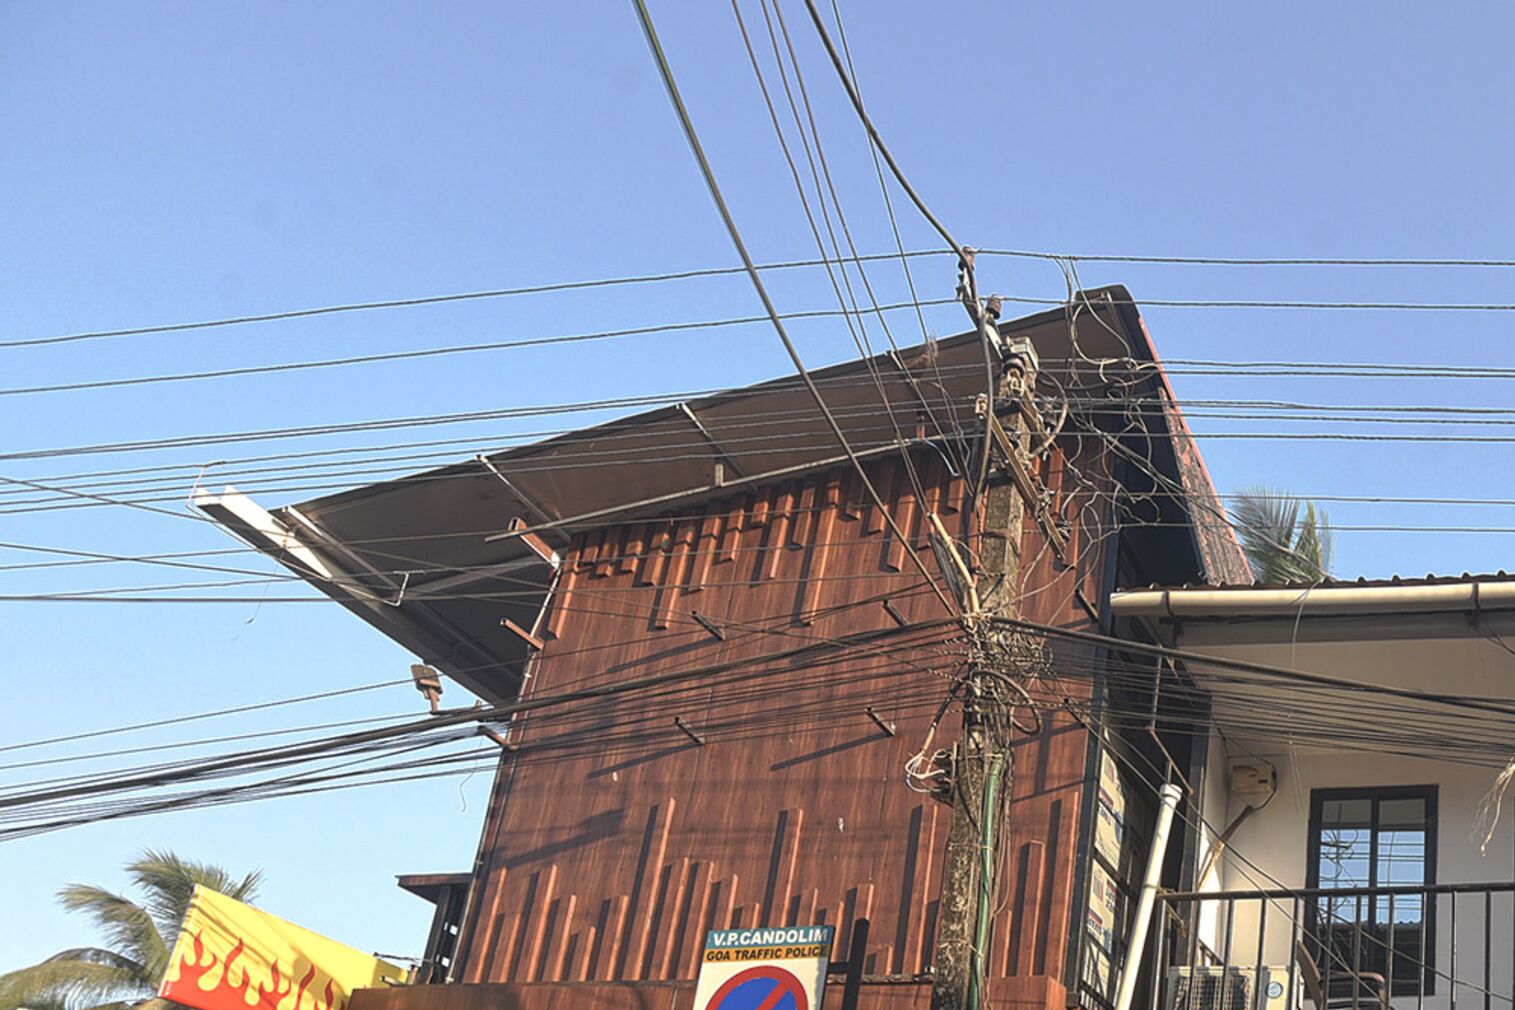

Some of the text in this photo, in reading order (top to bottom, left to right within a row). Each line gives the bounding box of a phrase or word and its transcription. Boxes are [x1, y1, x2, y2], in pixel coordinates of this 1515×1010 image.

[713, 929, 828, 946] V.P.CANDOLIM
[706, 946, 827, 961] GOA TRAFFIC POLICE
